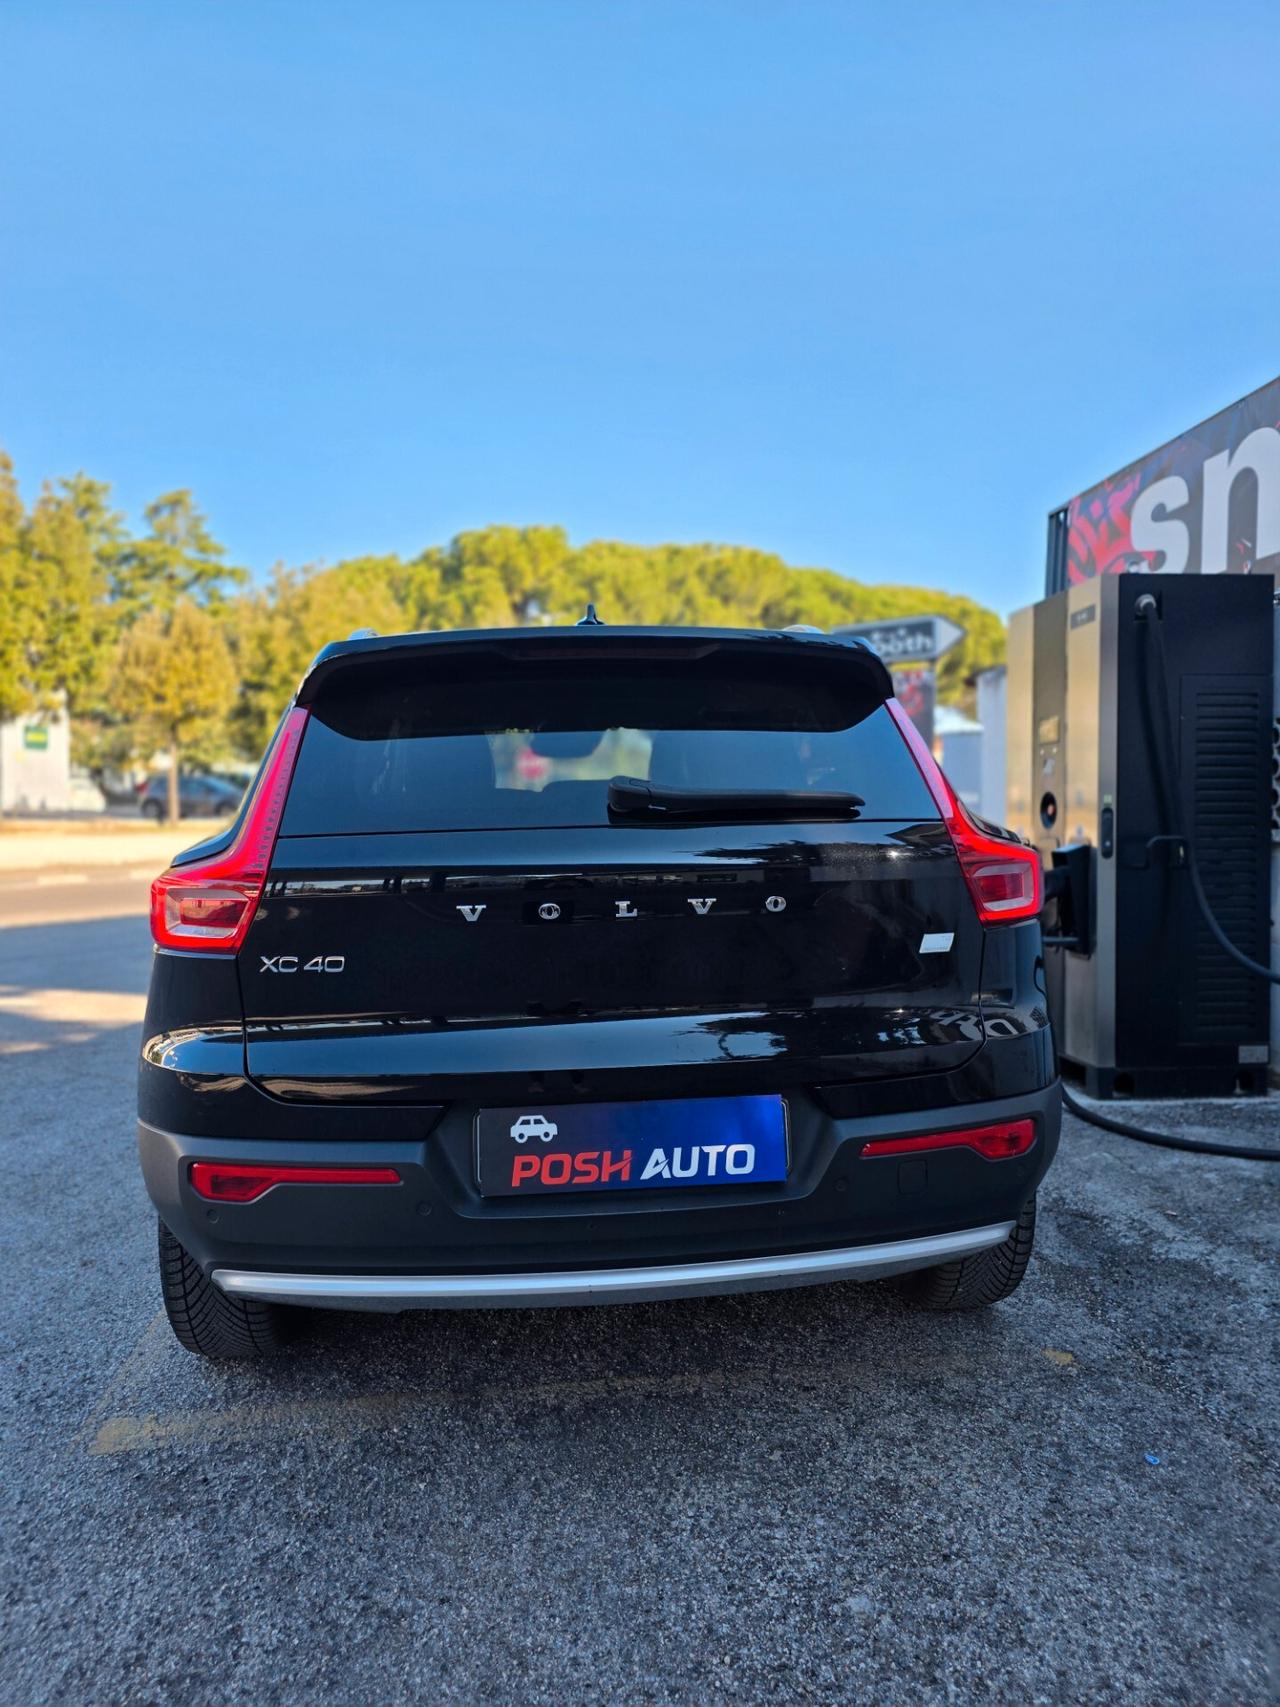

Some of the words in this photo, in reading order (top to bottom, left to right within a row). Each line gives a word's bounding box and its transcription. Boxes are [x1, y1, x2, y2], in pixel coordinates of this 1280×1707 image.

[456, 895, 787, 922] VOLVO
[511, 1150, 633, 1187] POSH
[639, 1143, 756, 1180] AUTO
